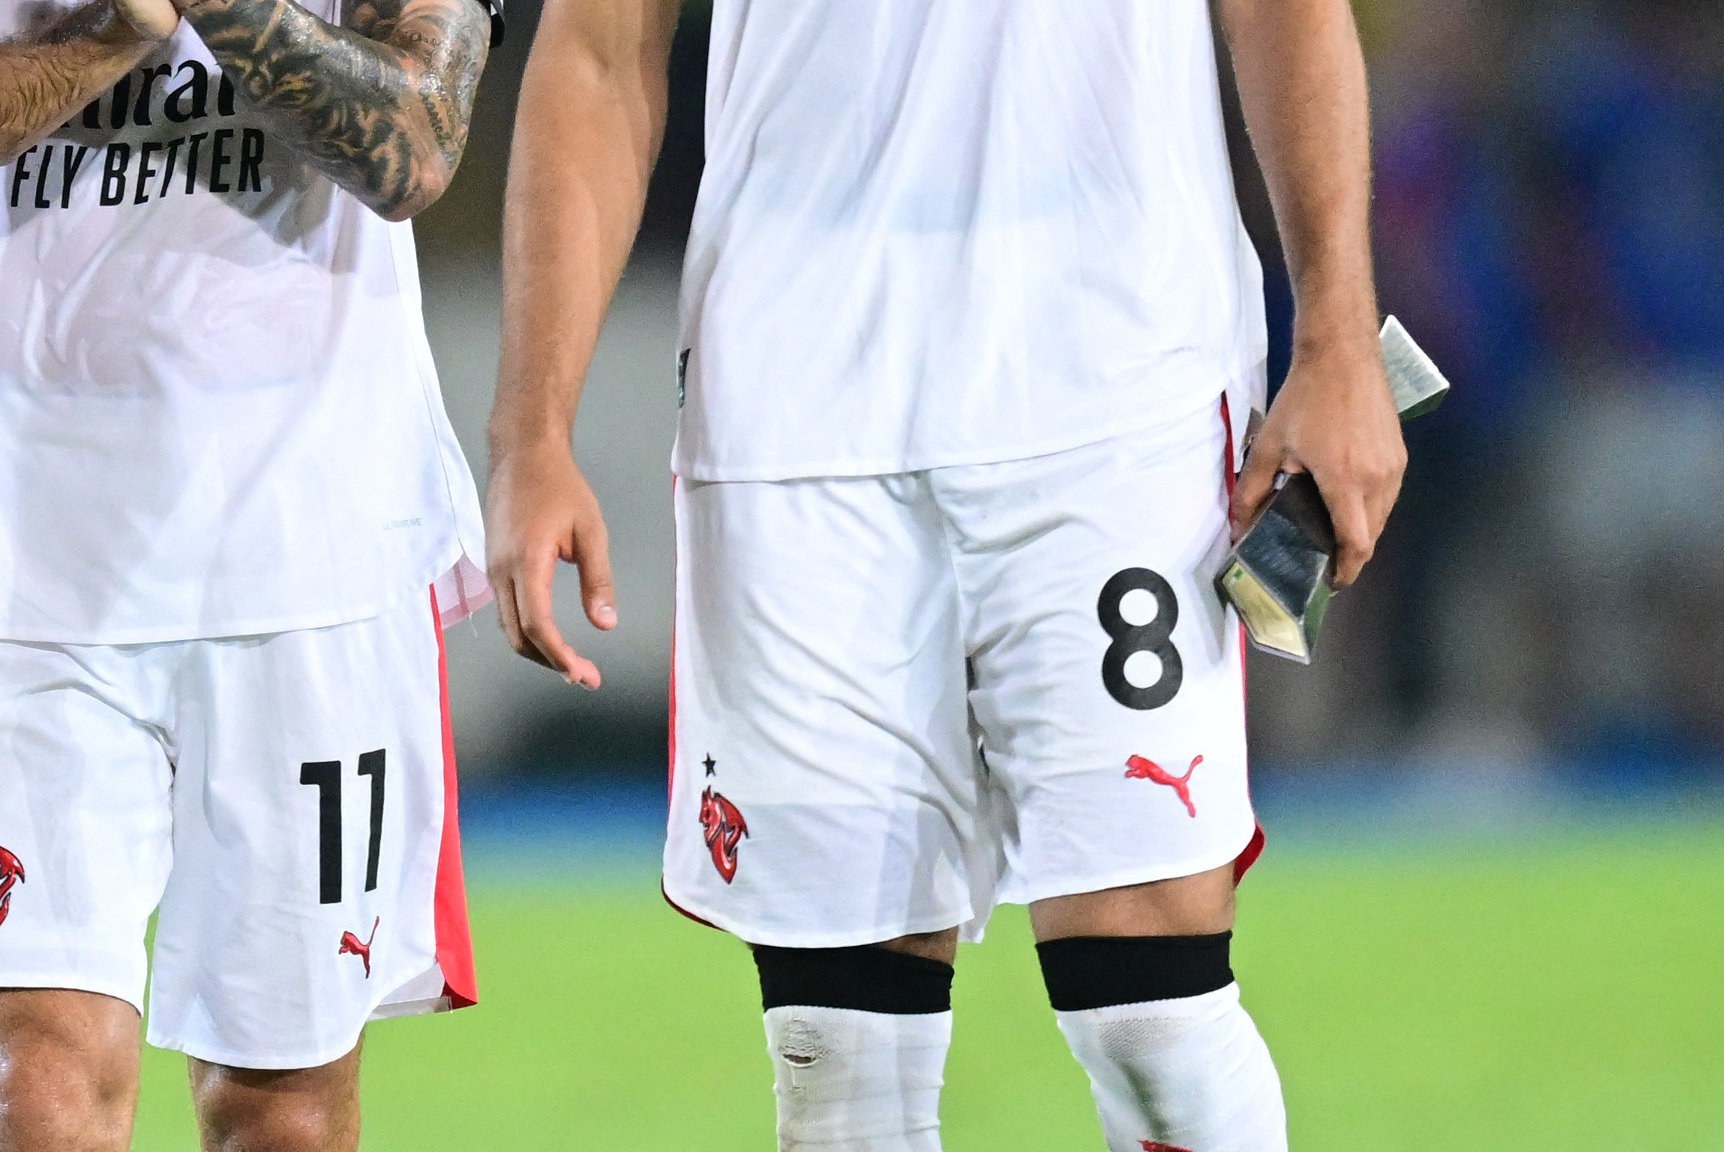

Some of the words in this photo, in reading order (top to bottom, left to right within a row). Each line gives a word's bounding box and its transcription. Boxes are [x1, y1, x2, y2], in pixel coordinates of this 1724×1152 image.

[10, 144, 87, 209] FLY
[99, 128, 265, 206] BETTER
[1097, 567, 1183, 710] 8
[300, 748, 386, 904] 11
